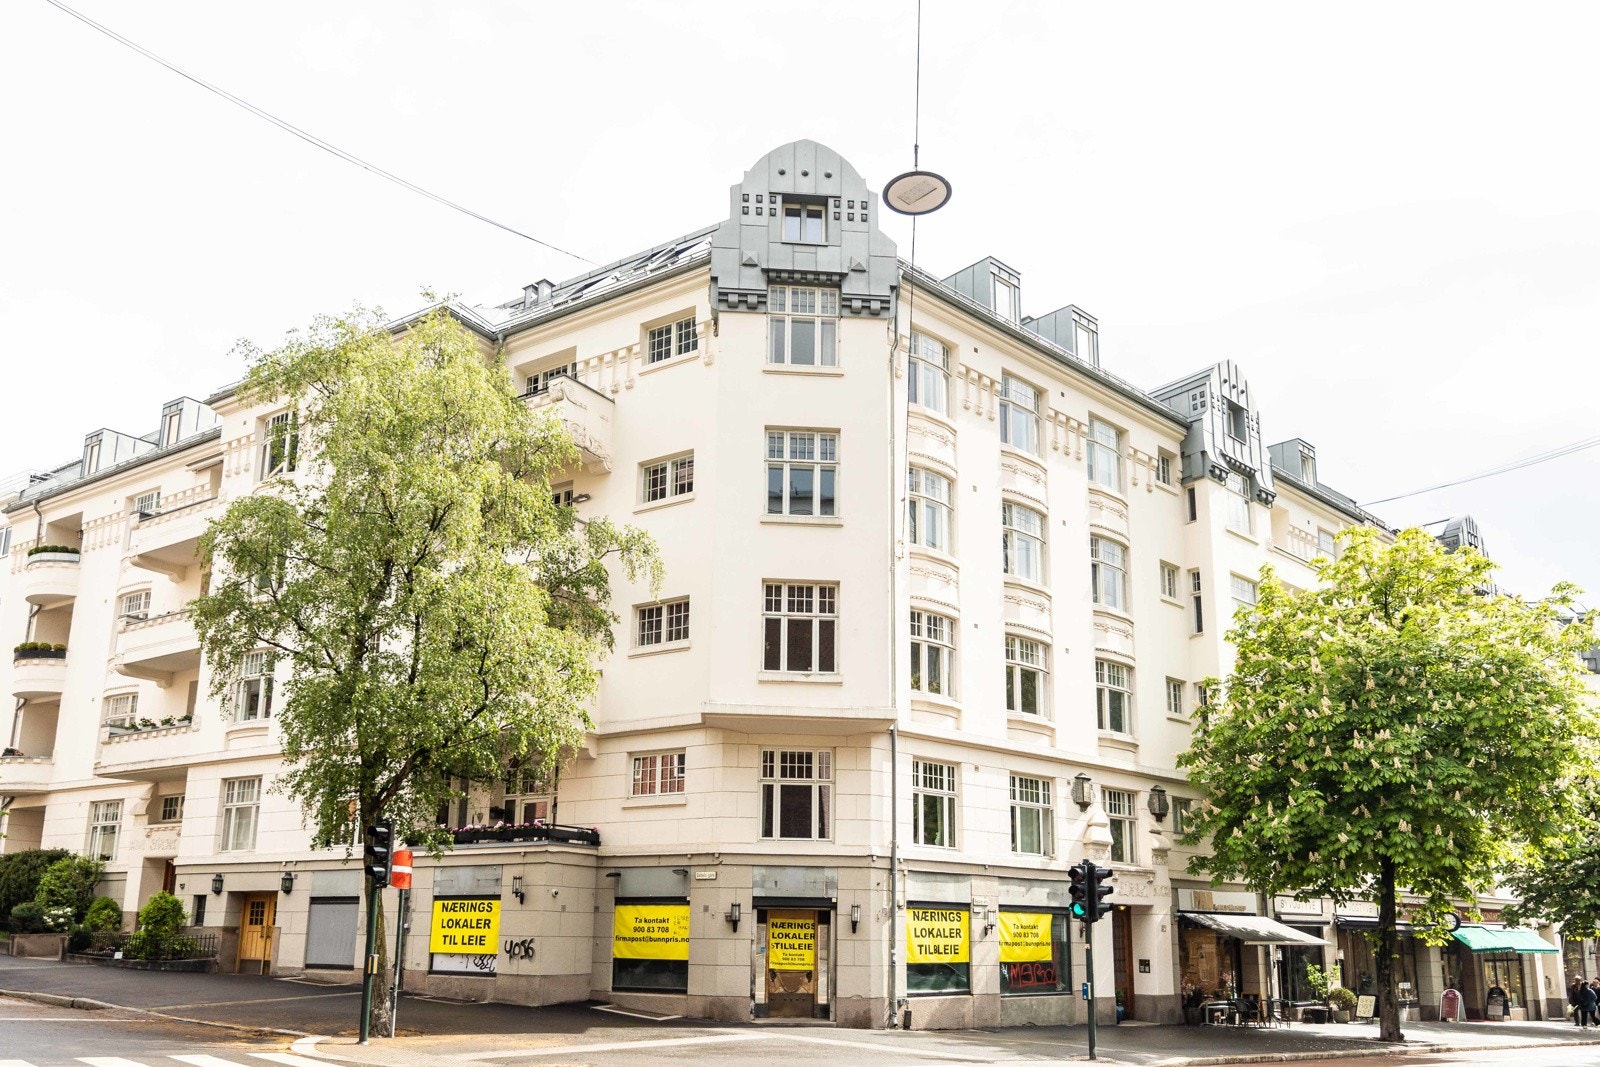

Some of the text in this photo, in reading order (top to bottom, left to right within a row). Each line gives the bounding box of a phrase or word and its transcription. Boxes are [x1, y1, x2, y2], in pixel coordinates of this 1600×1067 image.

[441, 902, 493, 913] NÆRINGS
[912, 911, 962, 922] NÆRINGS
[441, 918, 491, 929] LOKALER
[771, 922, 816, 930] NÆRINGS
[772, 932, 816, 940] LOKALER
[914, 928, 962, 938] LOKALER
[442, 934, 486, 946] TIL LEIE
[917, 944, 959, 954] TIL LEIE
